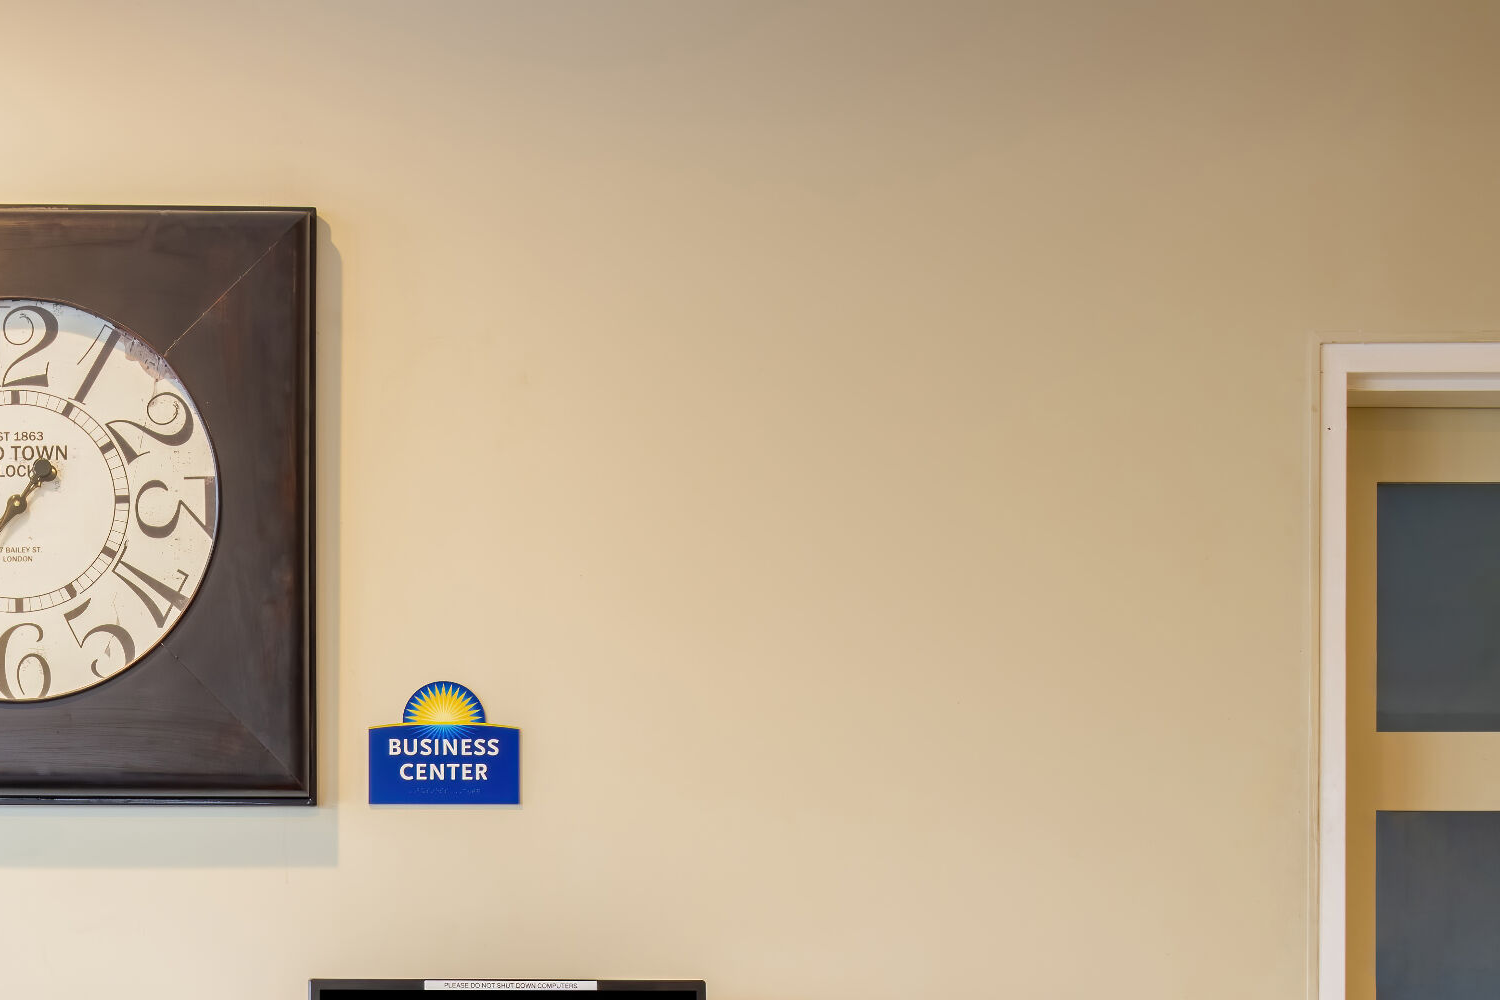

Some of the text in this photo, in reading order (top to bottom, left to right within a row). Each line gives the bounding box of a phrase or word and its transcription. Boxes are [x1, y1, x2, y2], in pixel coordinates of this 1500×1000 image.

[77, 324, 122, 405] 1
[11, 445, 68, 461] TOWN
[14, 431, 44, 441] 1863
[105, 391, 194, 465] 2
[135, 476, 216, 540] 3
[113, 541, 190, 628] 4
[64, 597, 136, 679] 5
[389, 738, 499, 756] BUSINESS
[400, 763, 488, 781] CENTER
